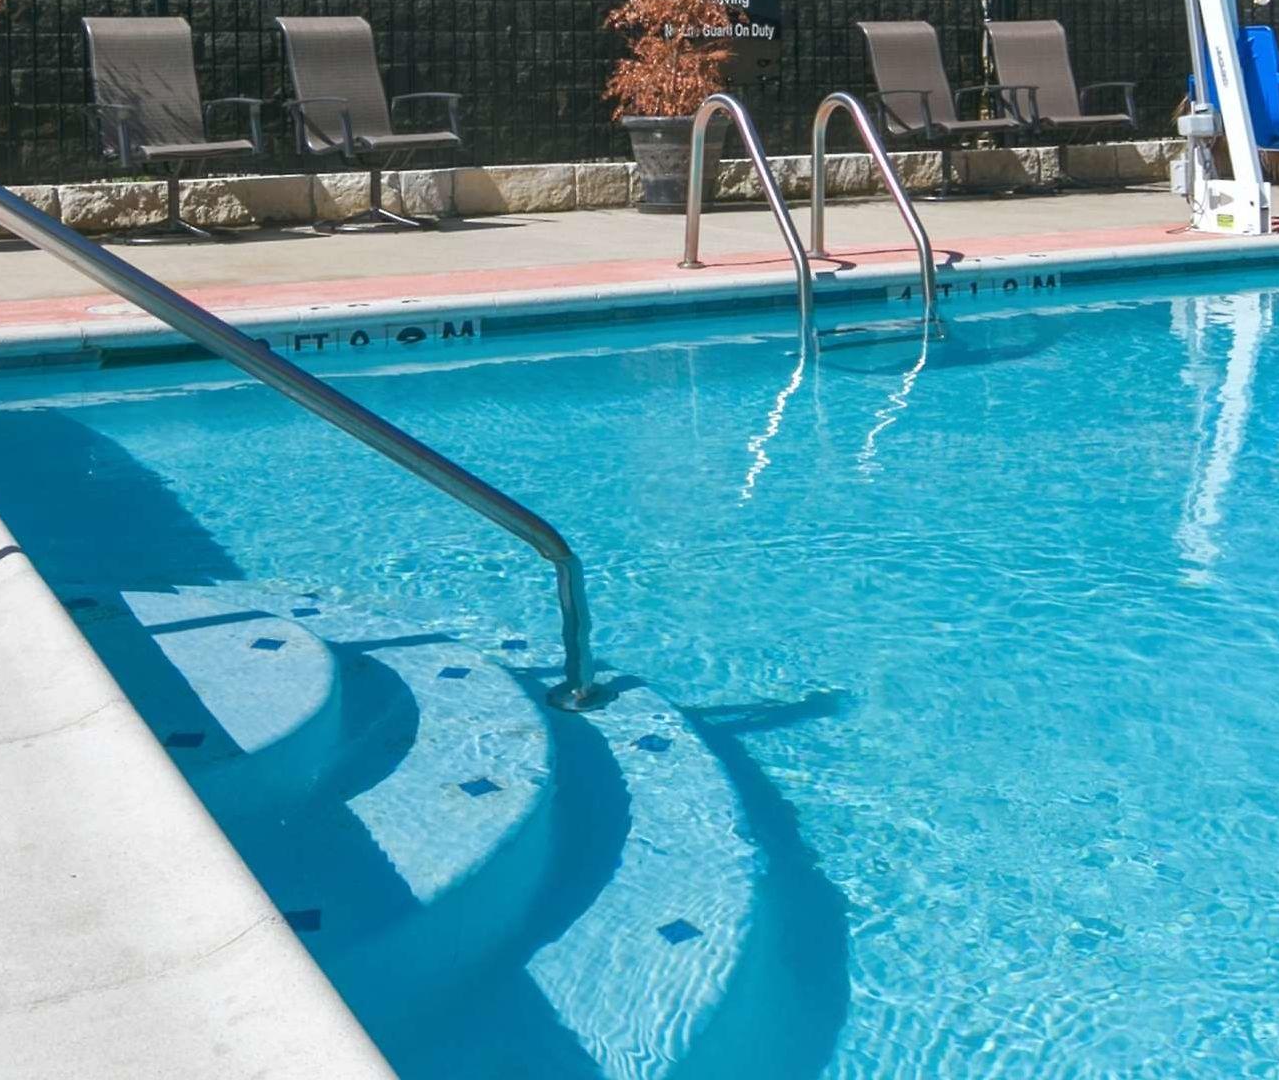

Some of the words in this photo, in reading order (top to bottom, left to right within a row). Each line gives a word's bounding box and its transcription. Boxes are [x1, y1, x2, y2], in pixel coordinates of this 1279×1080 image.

[702, 23, 733, 37] Guard
[734, 23, 750, 37] On
[751, 23, 774, 41] Duty
